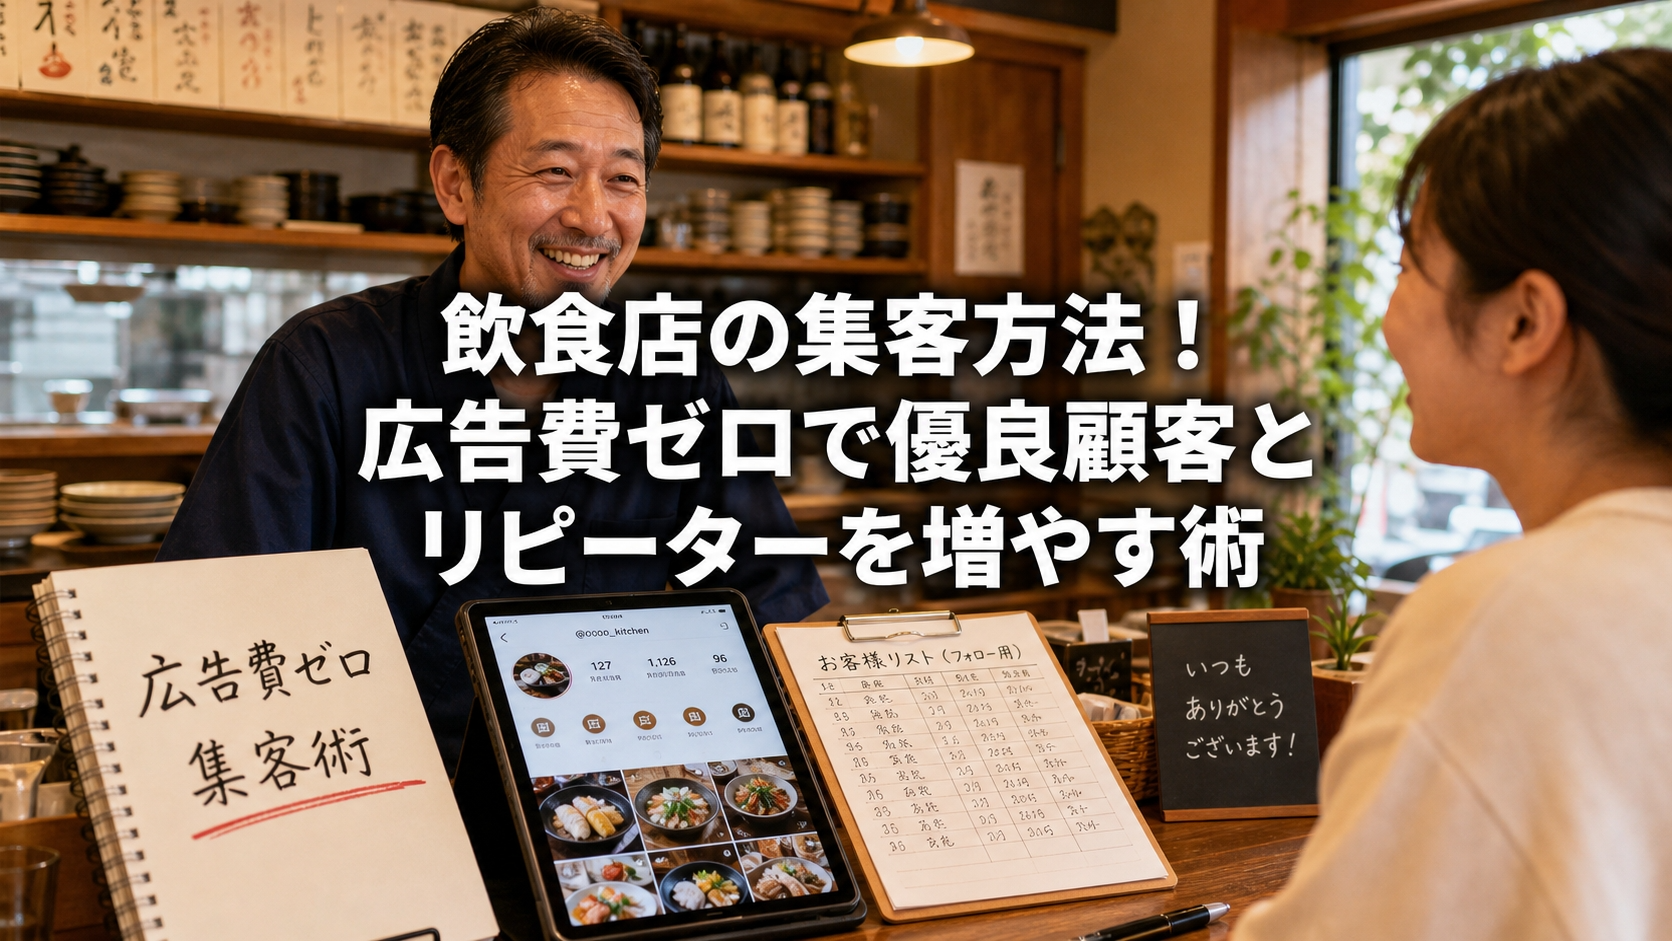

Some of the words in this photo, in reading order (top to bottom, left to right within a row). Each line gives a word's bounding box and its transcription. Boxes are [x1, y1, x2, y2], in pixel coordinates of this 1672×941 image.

[591, 660, 612, 671] 127
[712, 654, 728, 663] 96
[1186, 654, 1252, 677] いつも
[139, 639, 371, 718] 広告費ゼロ
[1186, 692, 1285, 721] ありがとう
[189, 727, 372, 807] 集客術
